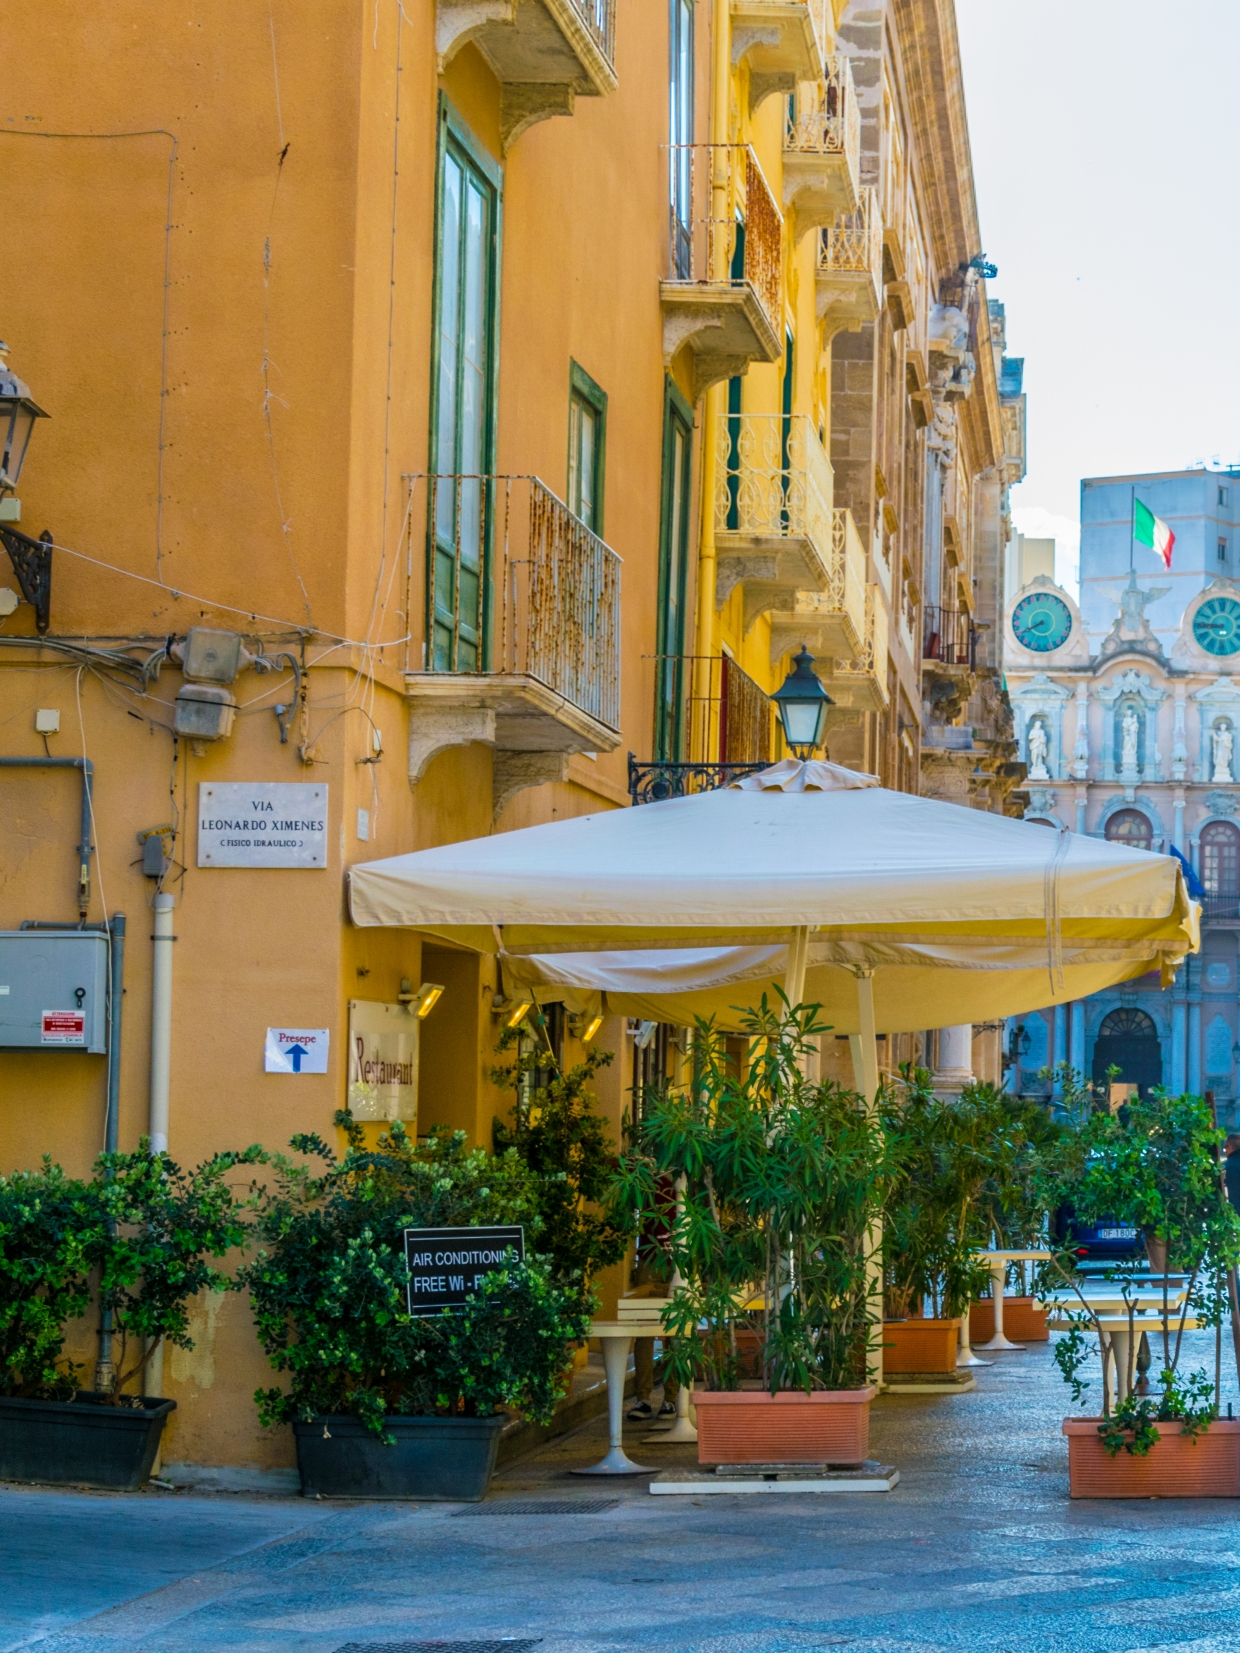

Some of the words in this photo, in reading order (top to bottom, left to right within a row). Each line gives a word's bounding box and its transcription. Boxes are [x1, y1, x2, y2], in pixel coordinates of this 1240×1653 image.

[252, 801, 274, 811] VIA
[202, 820, 267, 831] LEONARDO
[271, 821, 324, 831] XIMENES
[279, 1033, 316, 1046] Presepe
[355, 1037, 413, 1085] Restaurant
[412, 1252, 433, 1266] AIR
[414, 1276, 447, 1293] FREE
[449, 1275, 464, 1291] Wi
